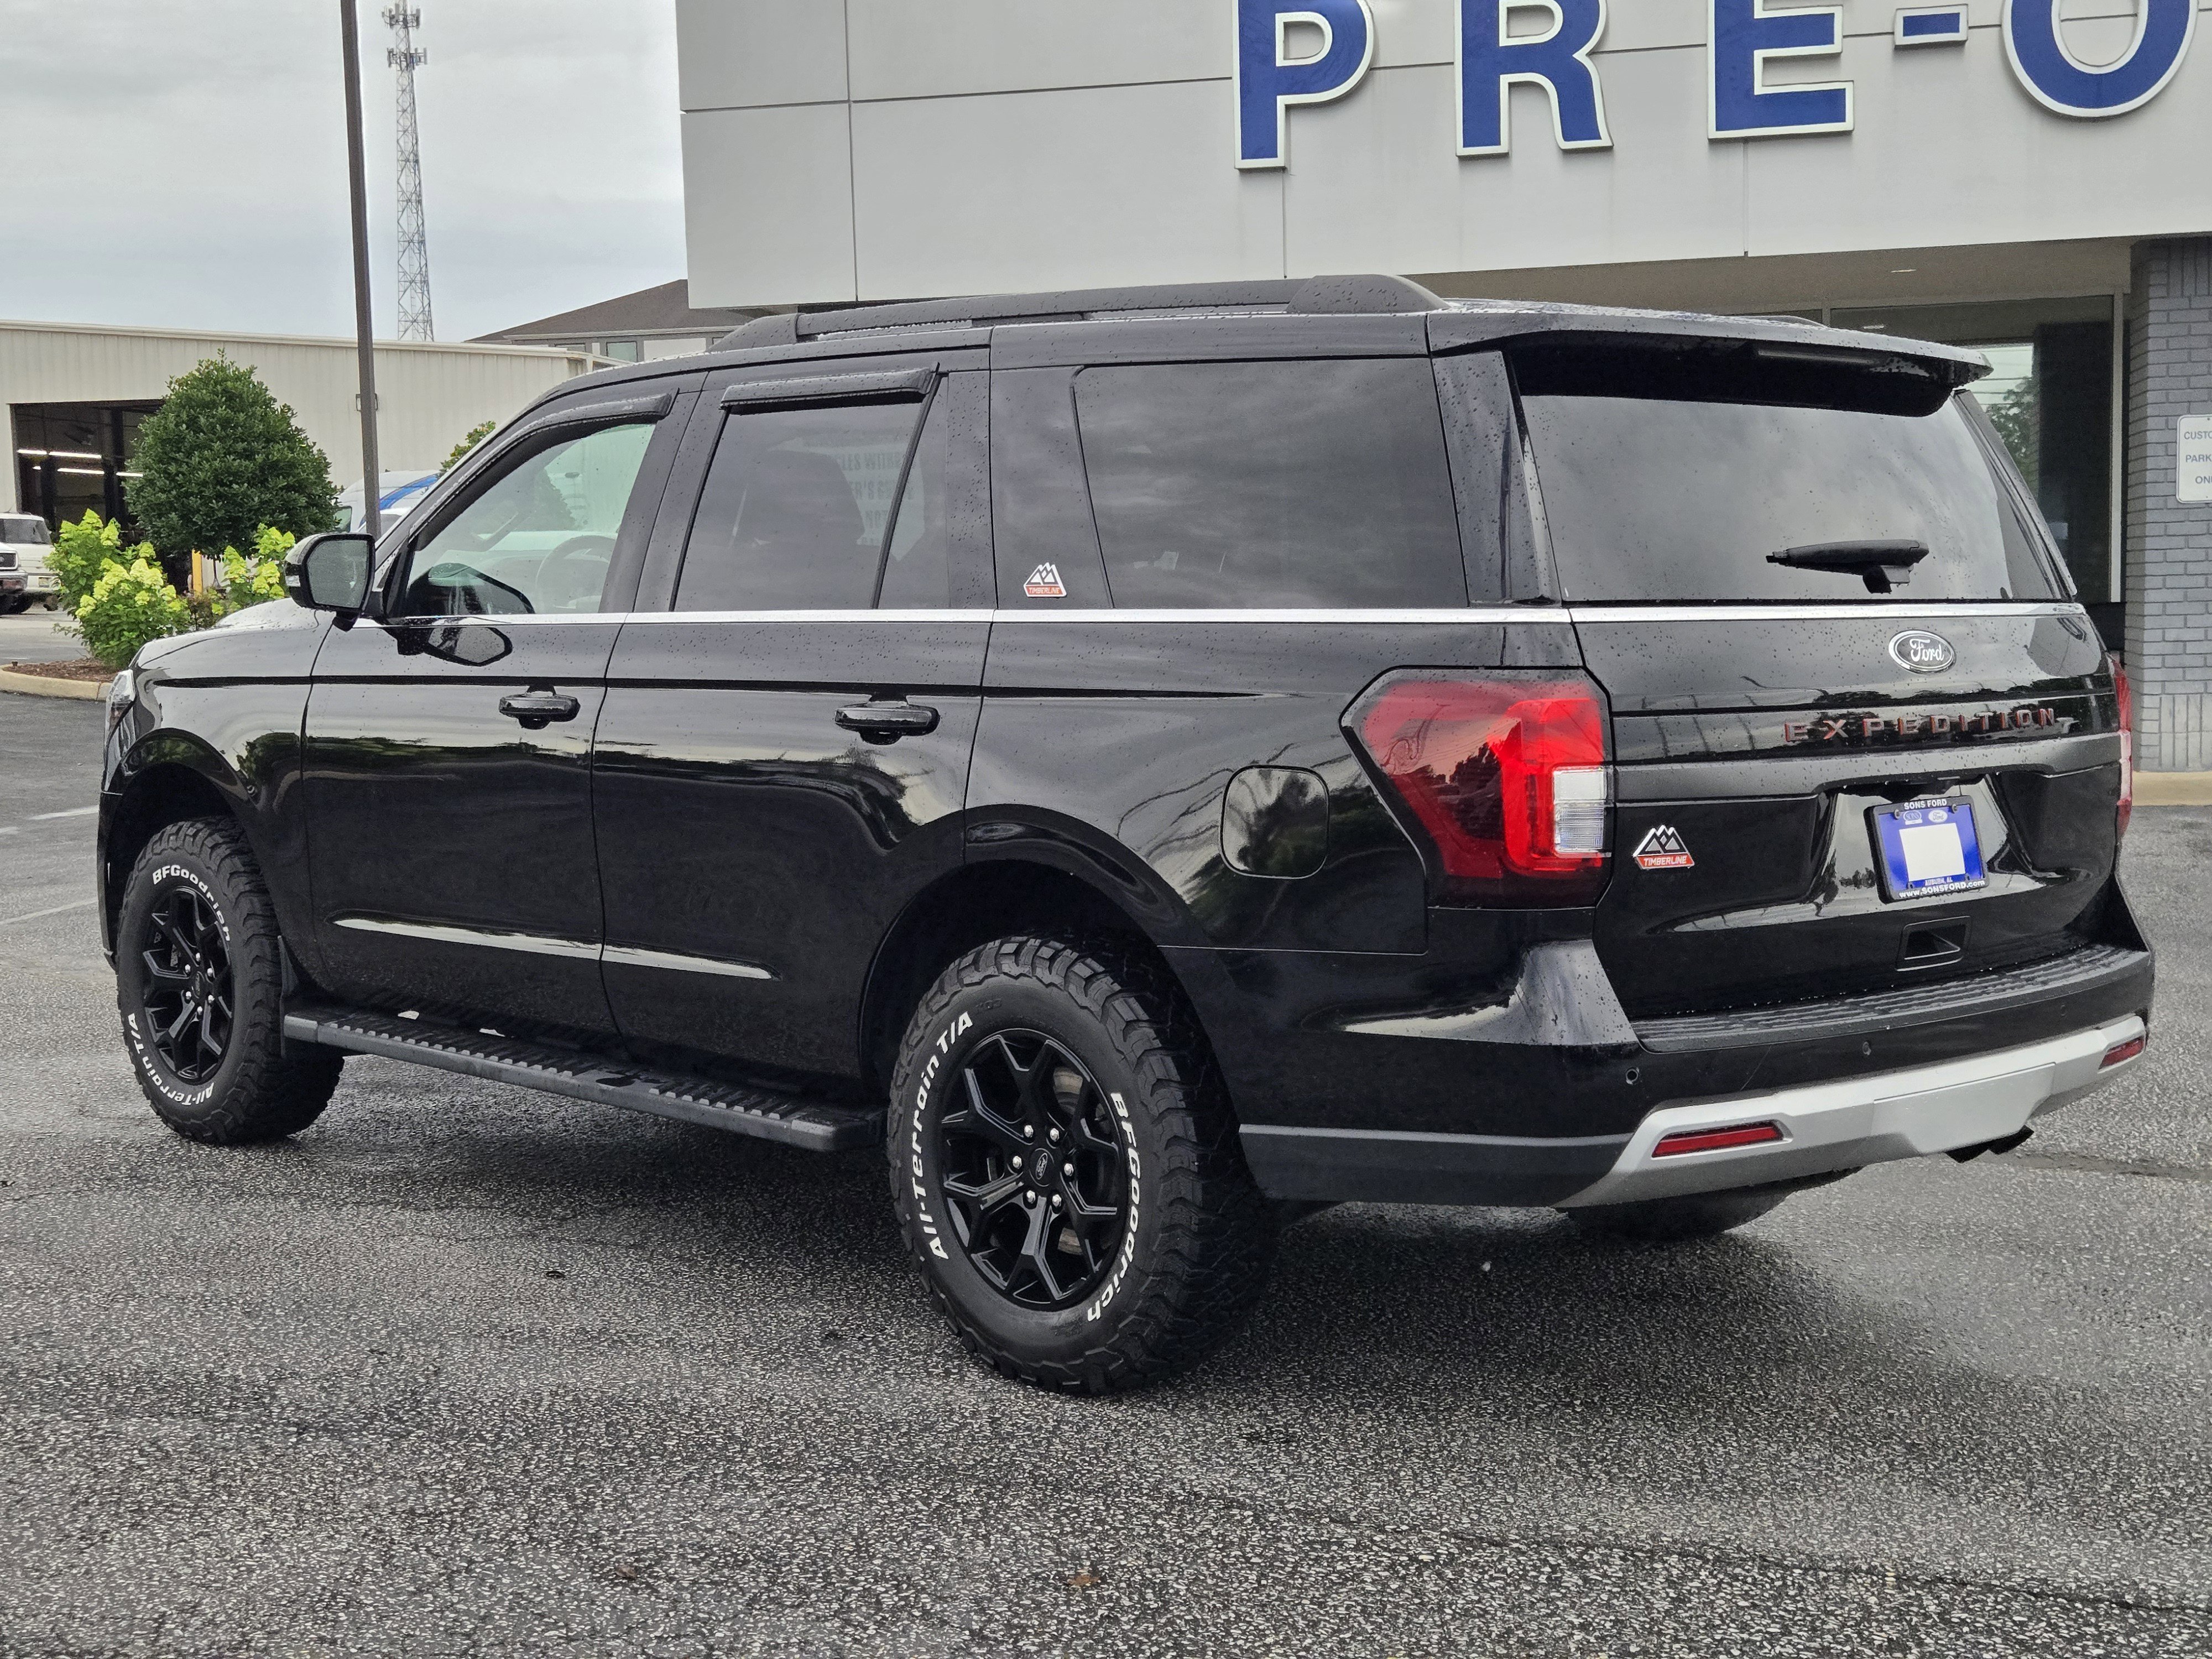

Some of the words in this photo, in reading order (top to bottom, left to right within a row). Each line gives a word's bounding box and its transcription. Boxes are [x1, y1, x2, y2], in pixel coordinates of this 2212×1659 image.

[2195, 476, 2212, 484] ON
[1908, 638, 1944, 663] Ford
[1784, 708, 2054, 743] EXPEDITION
[1903, 800, 1926, 810] SONS
[1927, 799, 1947, 808] FORD
[1643, 856, 1687, 866] TIMBERLINE
[152, 864, 231, 941] BFGoodrich
[1898, 880, 1985, 898] www.SONSFORD.com
[127, 1013, 149, 1054] T/A
[147, 1055, 215, 1105] All-Terrain
[912, 1055, 948, 1260] All-Terrain
[936, 1011, 973, 1054] T/A
[1087, 1092, 1141, 1322] BFGoodrich
